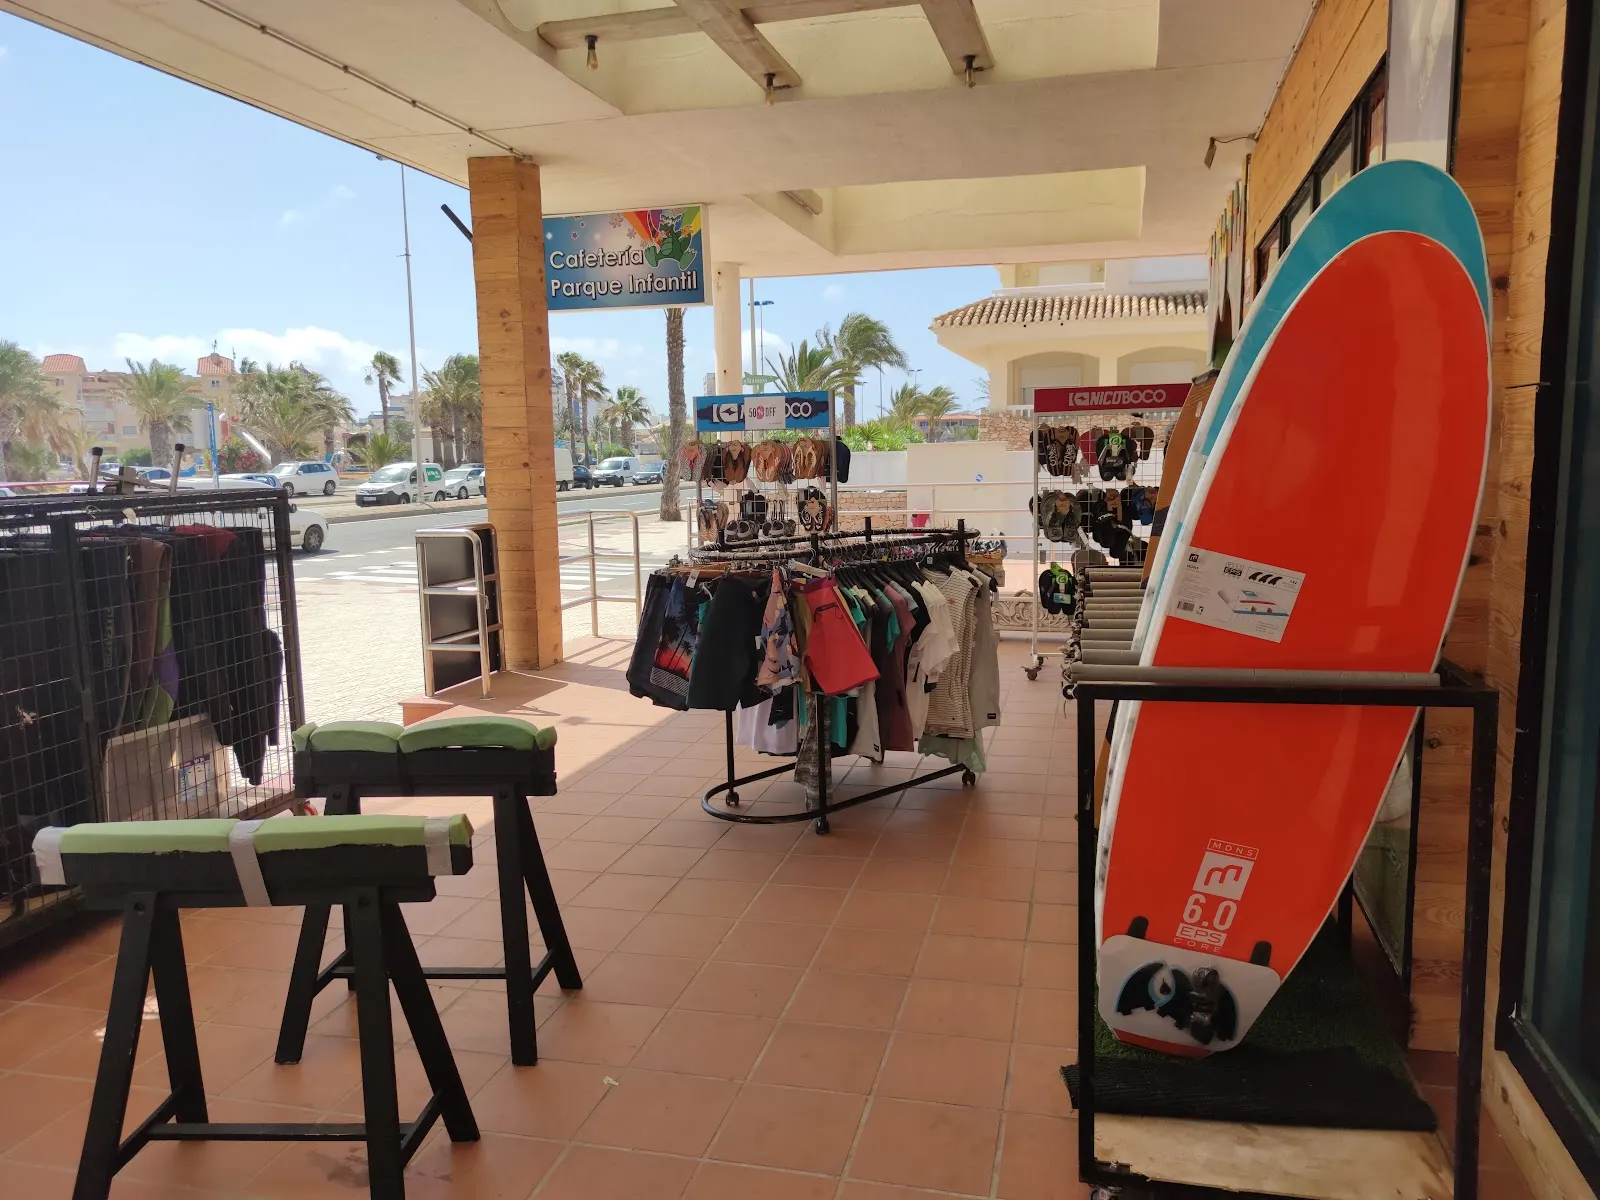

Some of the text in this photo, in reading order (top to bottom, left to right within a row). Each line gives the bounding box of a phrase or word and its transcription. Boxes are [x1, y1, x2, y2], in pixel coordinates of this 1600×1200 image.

[549, 245, 645, 270] Cafetería
[551, 271, 698, 300] Parque Infantil
[1089, 389, 1167, 406] NICOBOCO
[765, 406, 777, 417] OFF
[1182, 893, 1238, 931] 6.0
[1179, 926, 1222, 944] EPS
[1173, 937, 1221, 953] CORE
